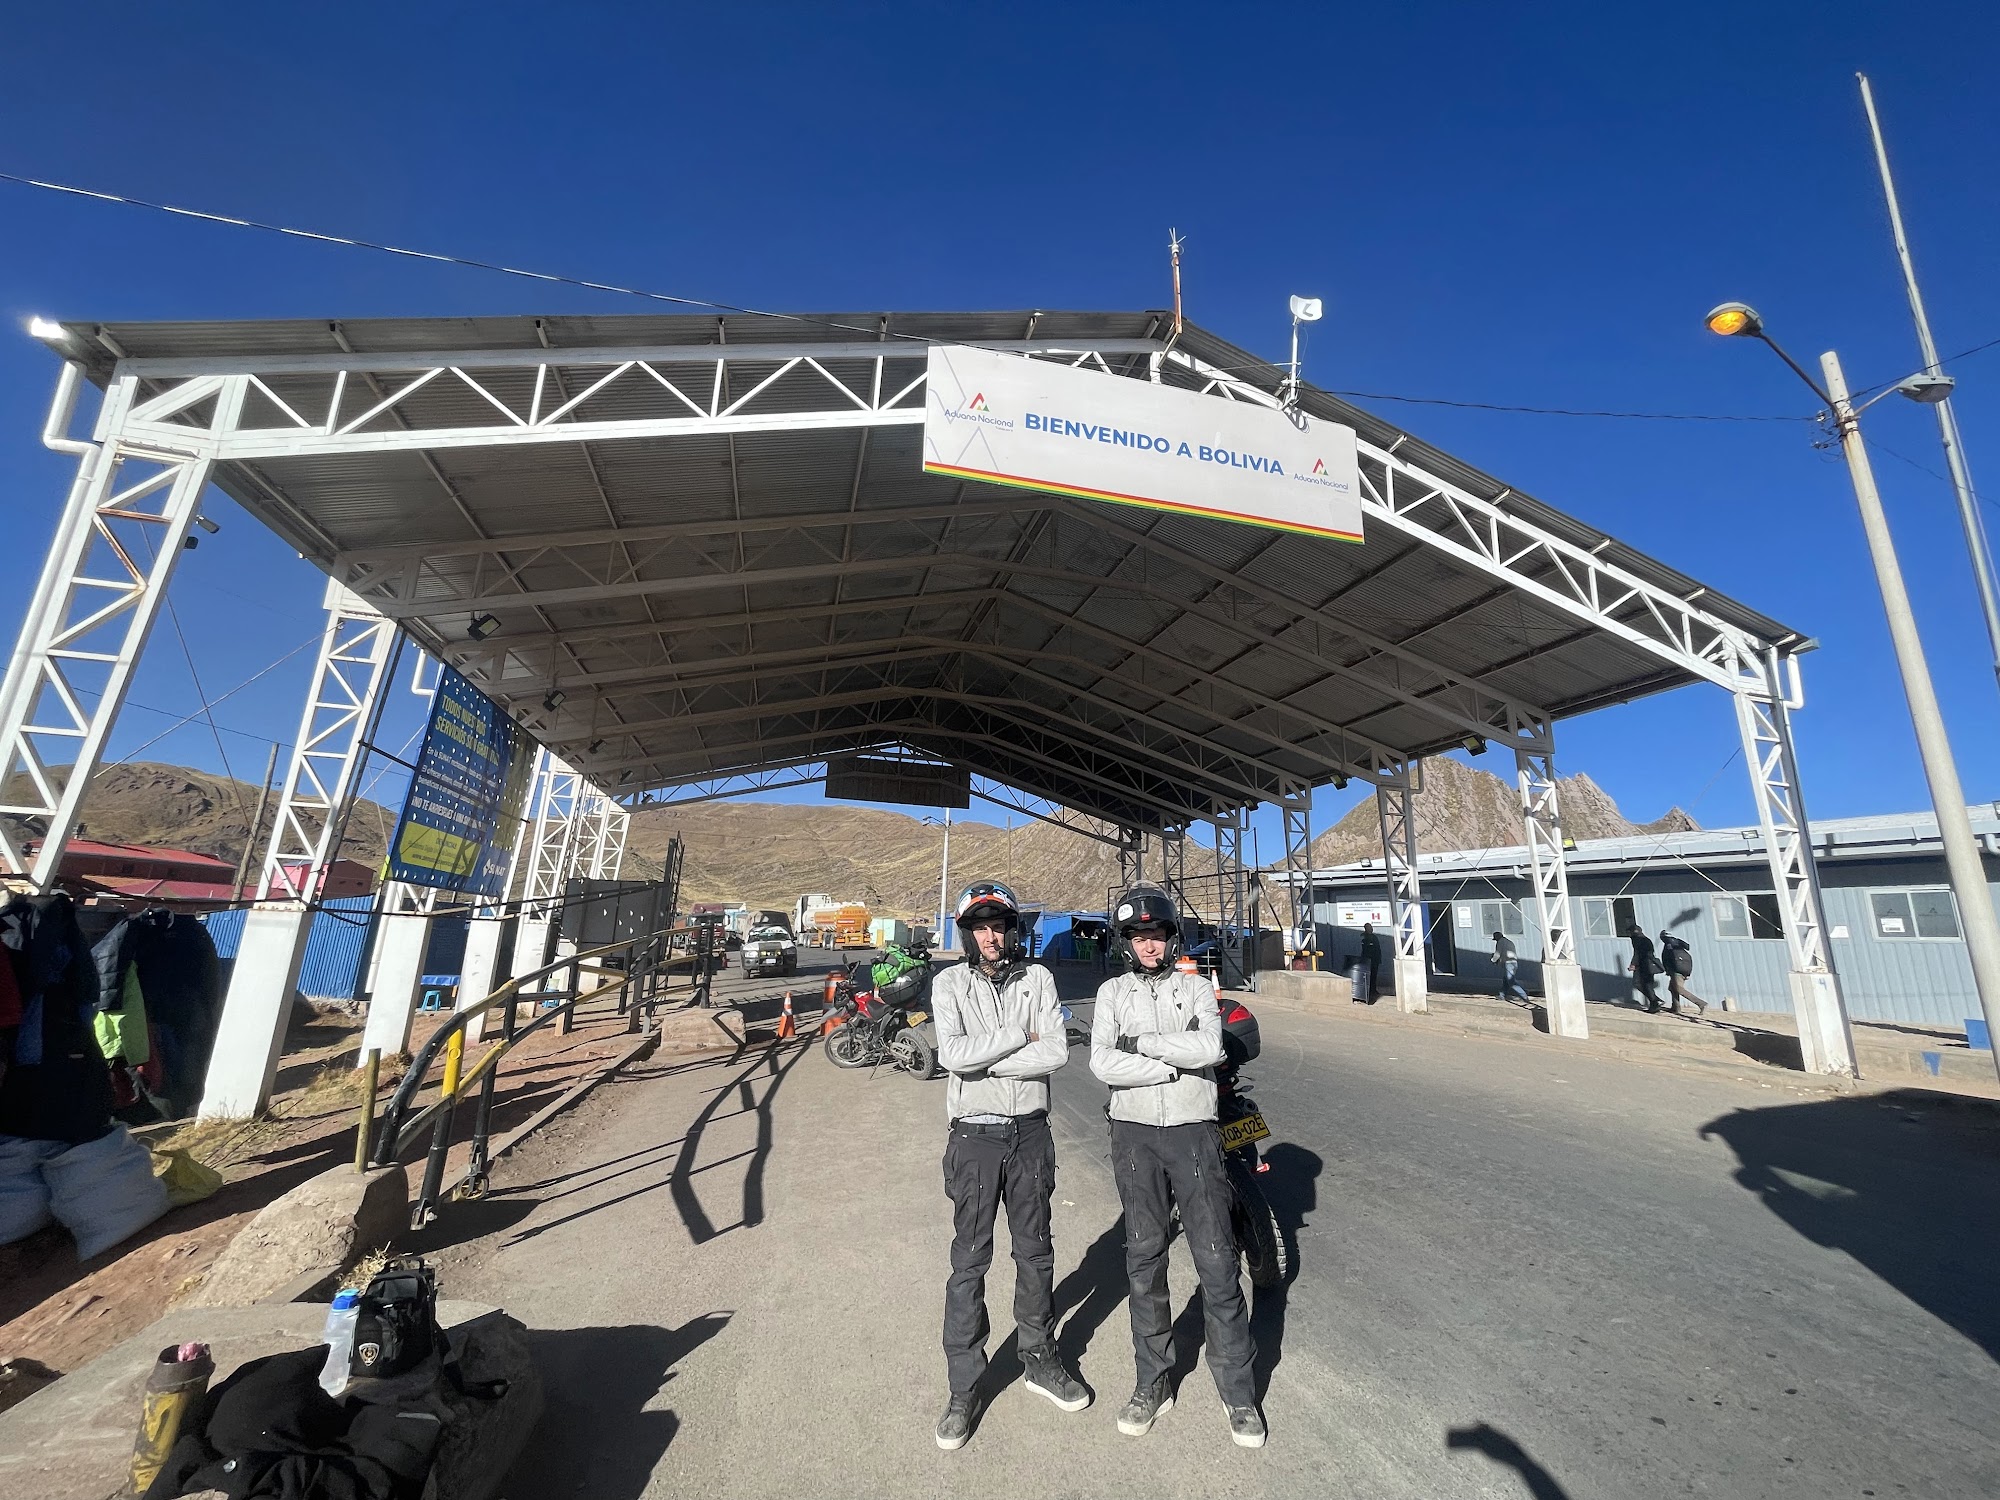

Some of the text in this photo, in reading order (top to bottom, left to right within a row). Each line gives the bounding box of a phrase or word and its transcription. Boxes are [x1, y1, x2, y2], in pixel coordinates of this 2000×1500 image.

[944, 409, 1014, 428] Aduana Nacional
[1025, 412, 1285, 476] BIENVENIDO A BOLIVIA
[1293, 473, 1349, 490] Aduana Nacional
[441, 694, 462, 719] TODOS
[435, 715, 467, 745] SERVICIOS
[488, 863, 506, 877] SUNAT
